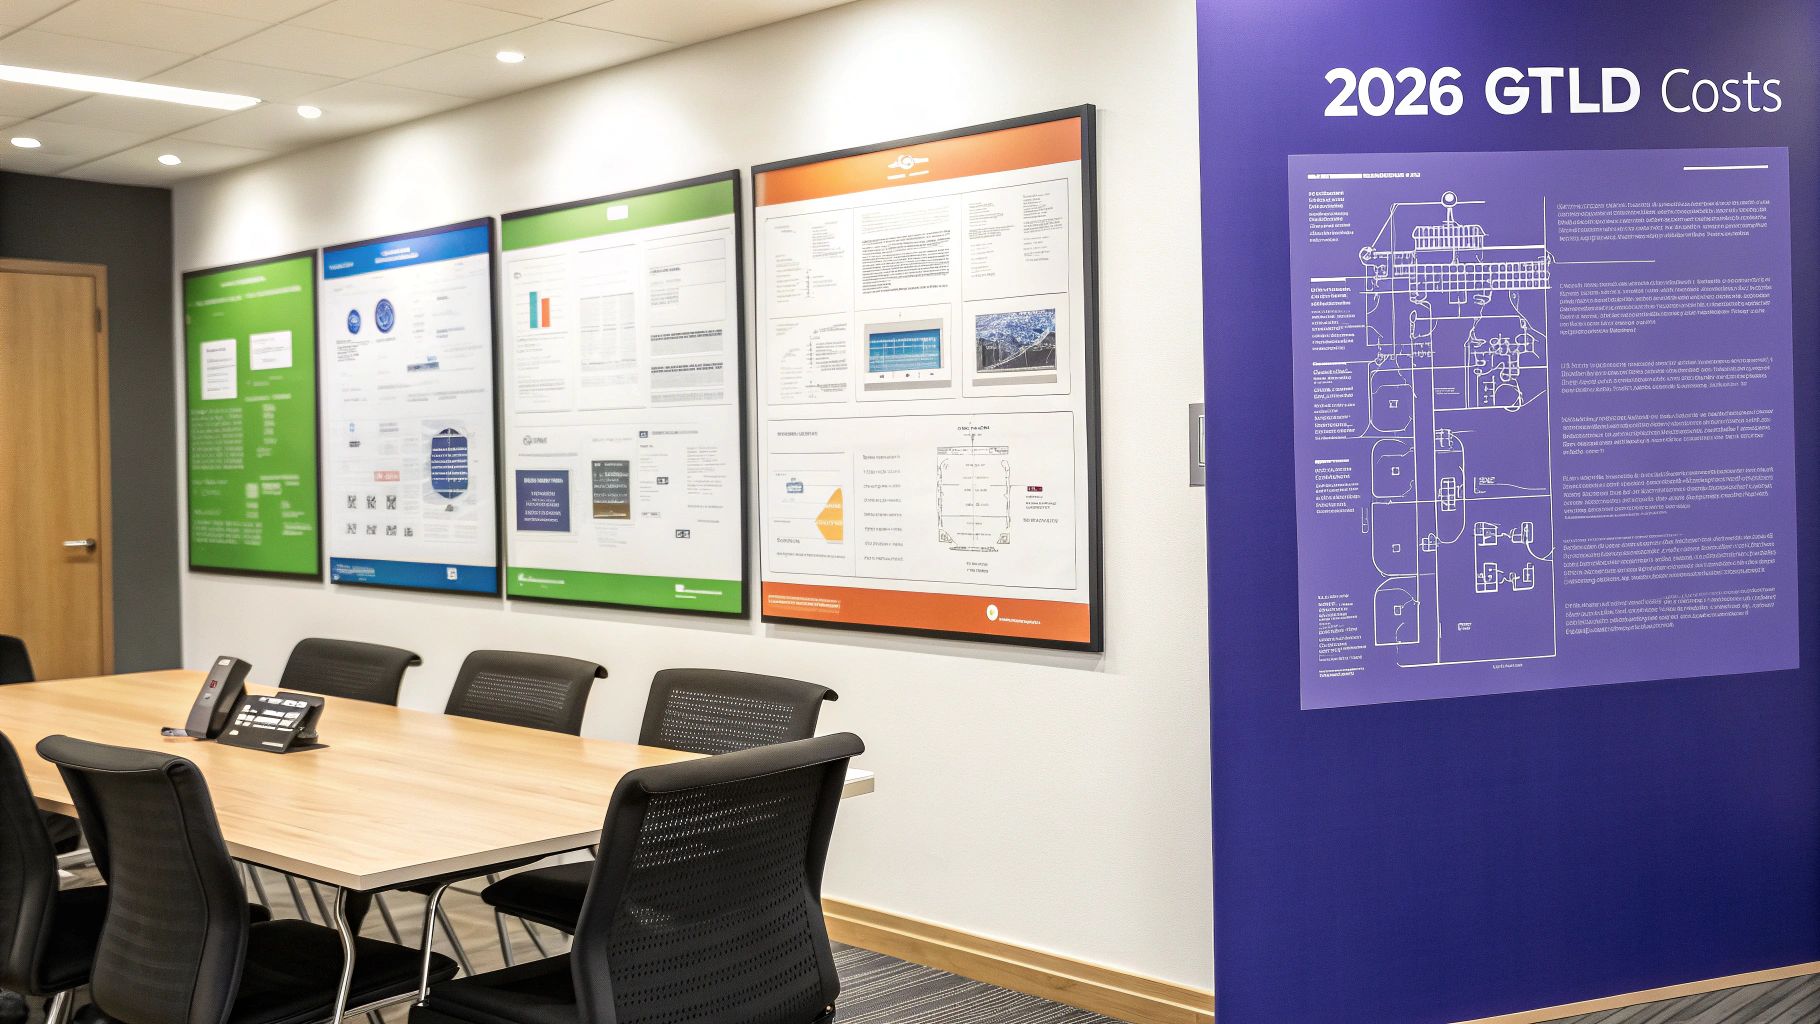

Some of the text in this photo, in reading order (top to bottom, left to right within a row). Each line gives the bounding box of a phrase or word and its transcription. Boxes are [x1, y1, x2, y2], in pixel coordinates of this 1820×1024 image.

[1324, 66, 1782, 117] 2026 GTLD Costs
